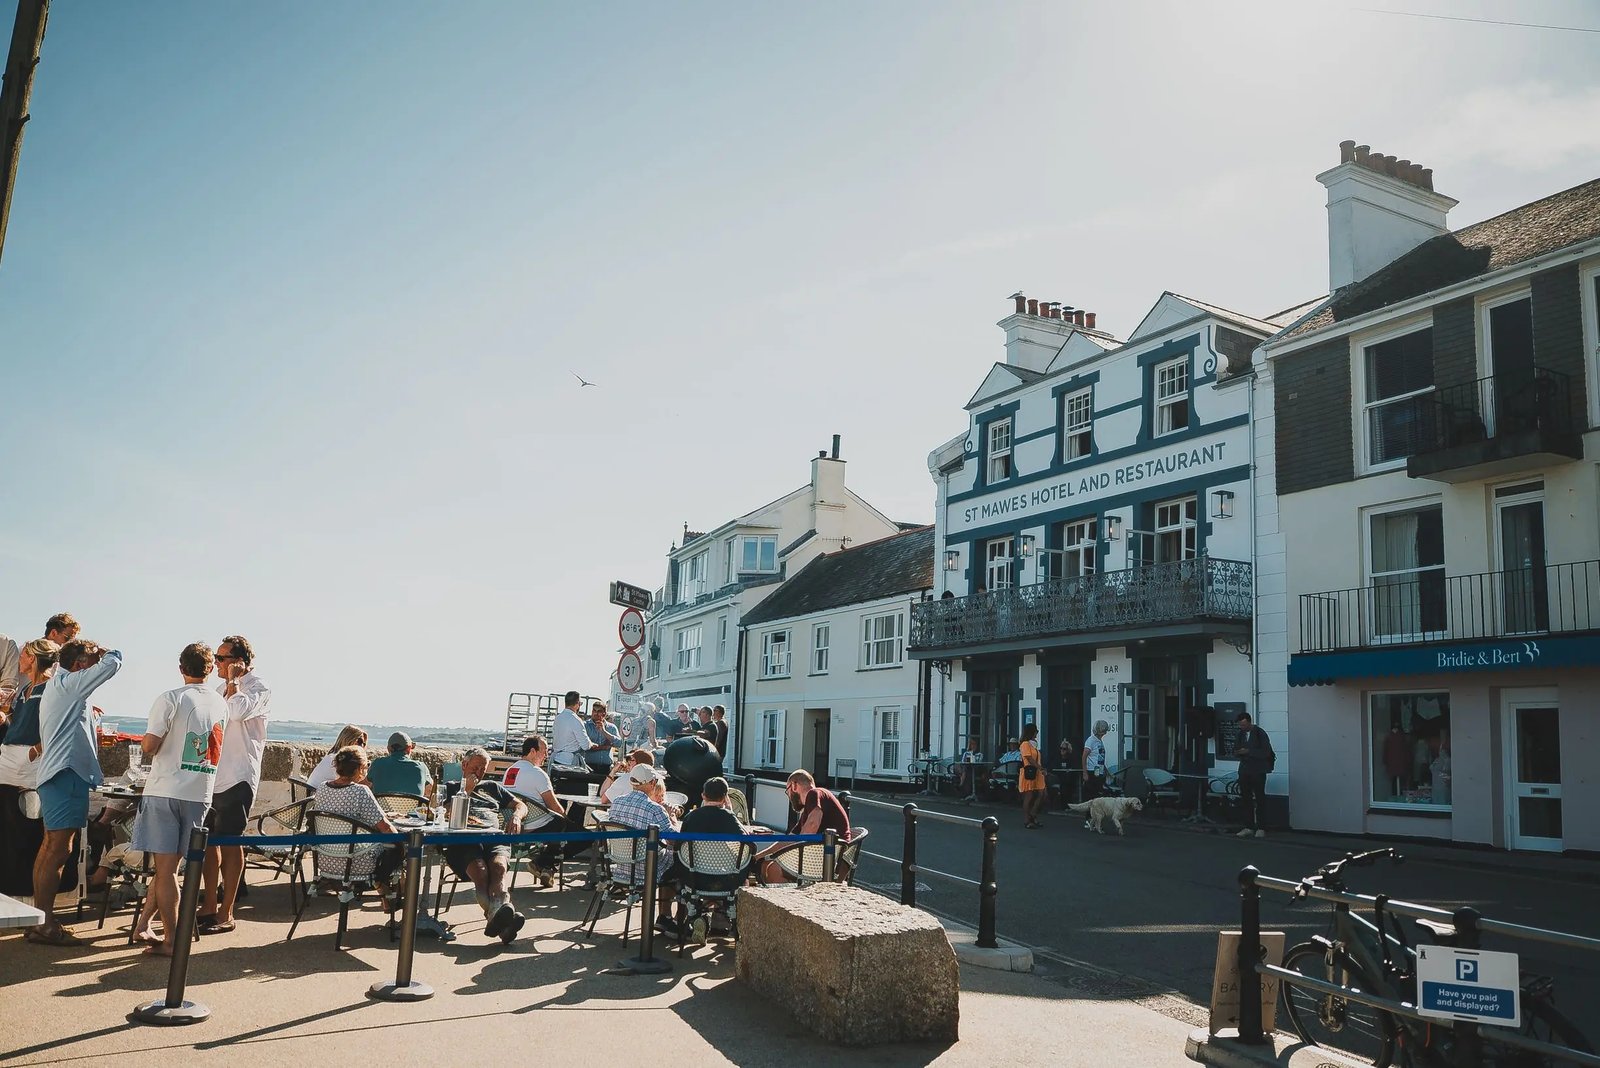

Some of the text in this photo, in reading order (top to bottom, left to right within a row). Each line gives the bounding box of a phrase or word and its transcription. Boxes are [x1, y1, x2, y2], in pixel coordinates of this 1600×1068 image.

[965, 442, 1226, 523] ST MAWES HOTEL AND RESTAURANT
[1437, 648, 1521, 668] Bridie & Bert
[1103, 665, 1119, 674] BAR
[1459, 960, 1474, 980] P
[1220, 982, 1275, 993] BARY
[1438, 988, 1498, 1002] Have you paid
[1436, 998, 1500, 1012] and displayed?
